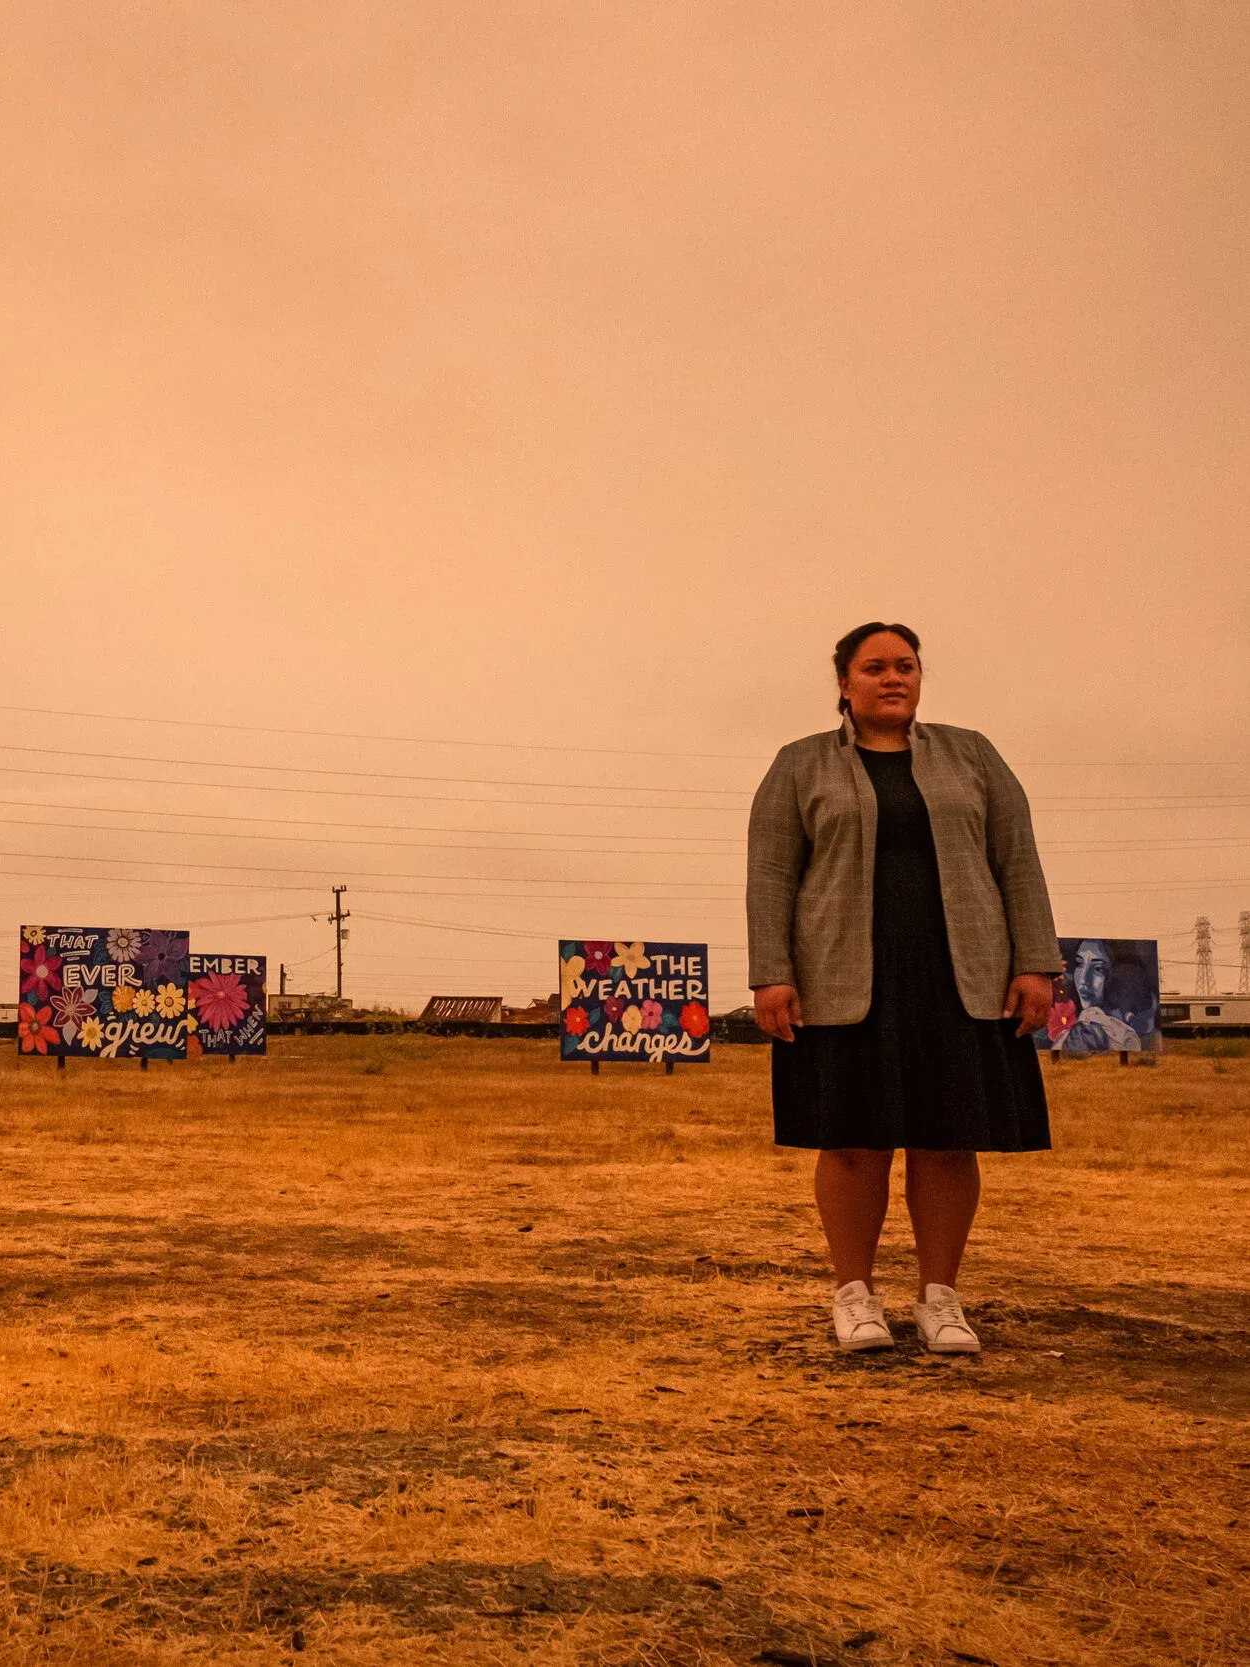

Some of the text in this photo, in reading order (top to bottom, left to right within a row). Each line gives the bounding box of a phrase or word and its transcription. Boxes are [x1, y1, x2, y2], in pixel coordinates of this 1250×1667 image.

[47, 933, 98, 949] THAT
[63, 964, 142, 988] EVER
[651, 954, 702, 976] THE
[571, 978, 707, 1000] WEATHER
[198, 1004, 264, 1048] THAT WHEN
[576, 1022, 711, 1063] changes
